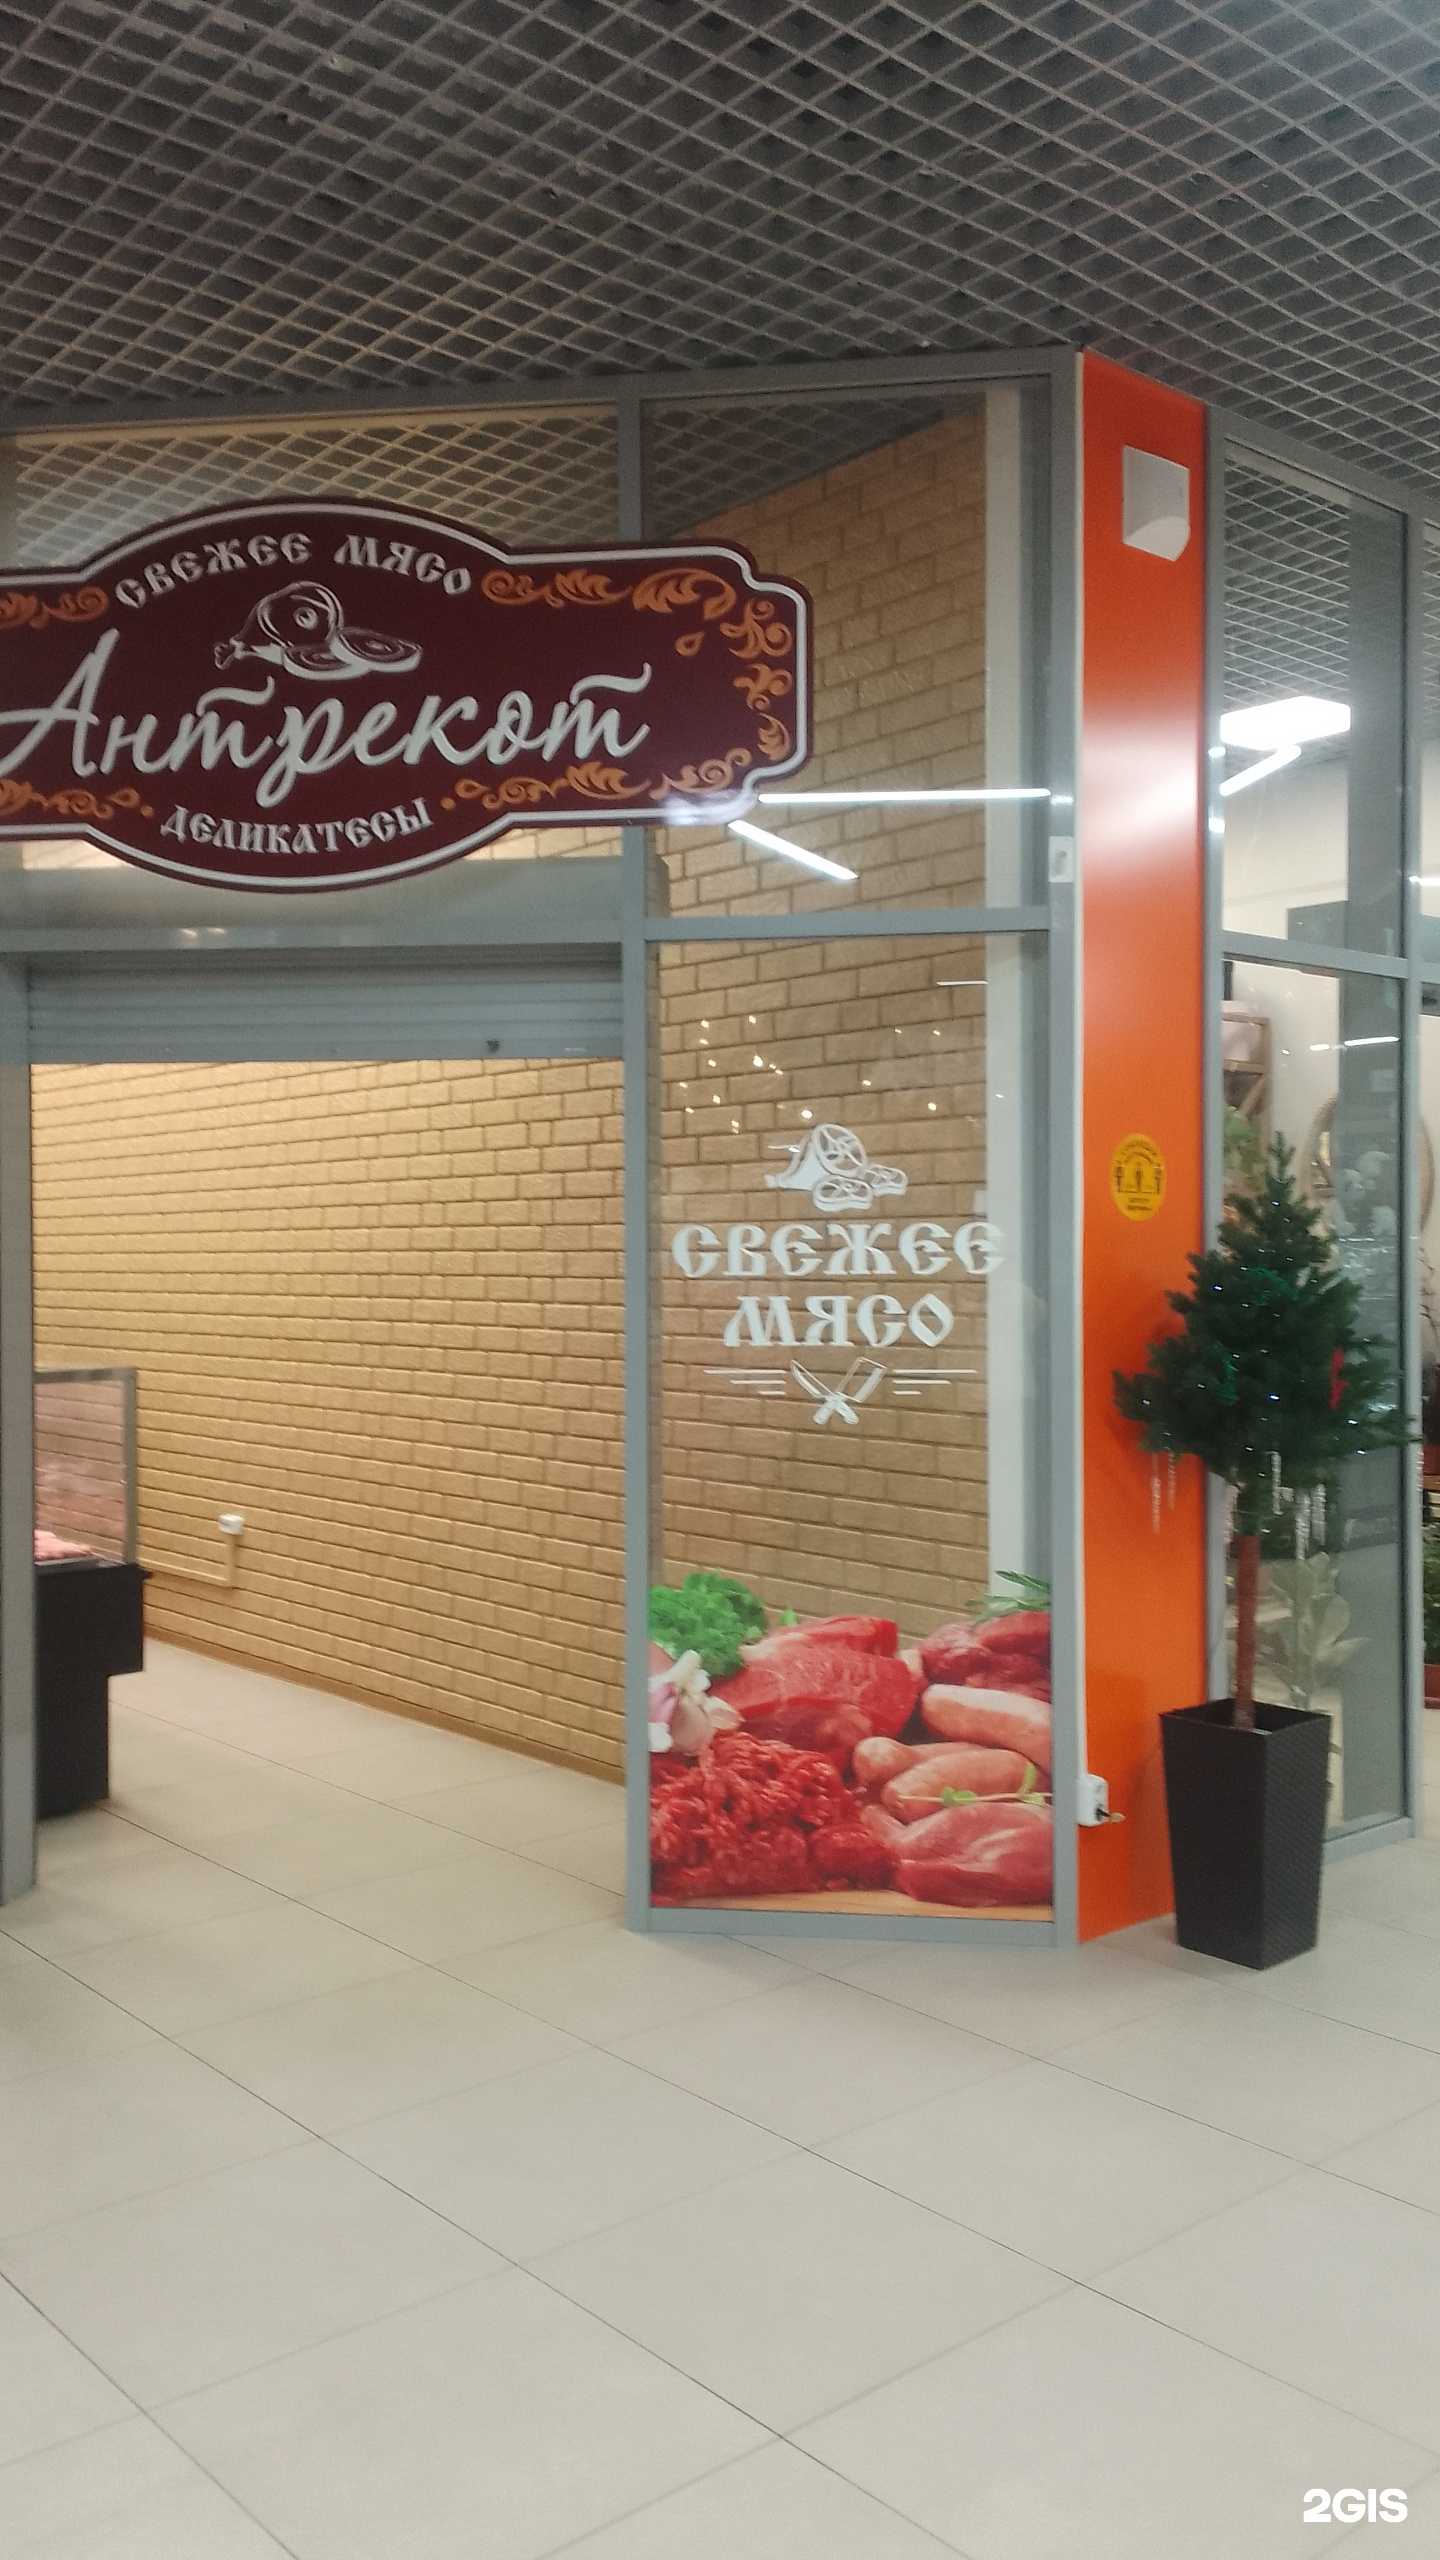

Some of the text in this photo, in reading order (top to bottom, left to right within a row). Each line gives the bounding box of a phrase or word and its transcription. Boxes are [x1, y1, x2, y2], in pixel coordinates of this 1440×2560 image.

[115, 534, 473, 608] СВЕЖЕЕ МЯСО
[0, 628, 653, 807] Антрекот
[161, 797, 434, 856] ДЕЛИКАТЕСЫ
[672, 1222, 1006, 1278] СВЕЖЕЕ
[723, 1294, 954, 1347] МЯСО
